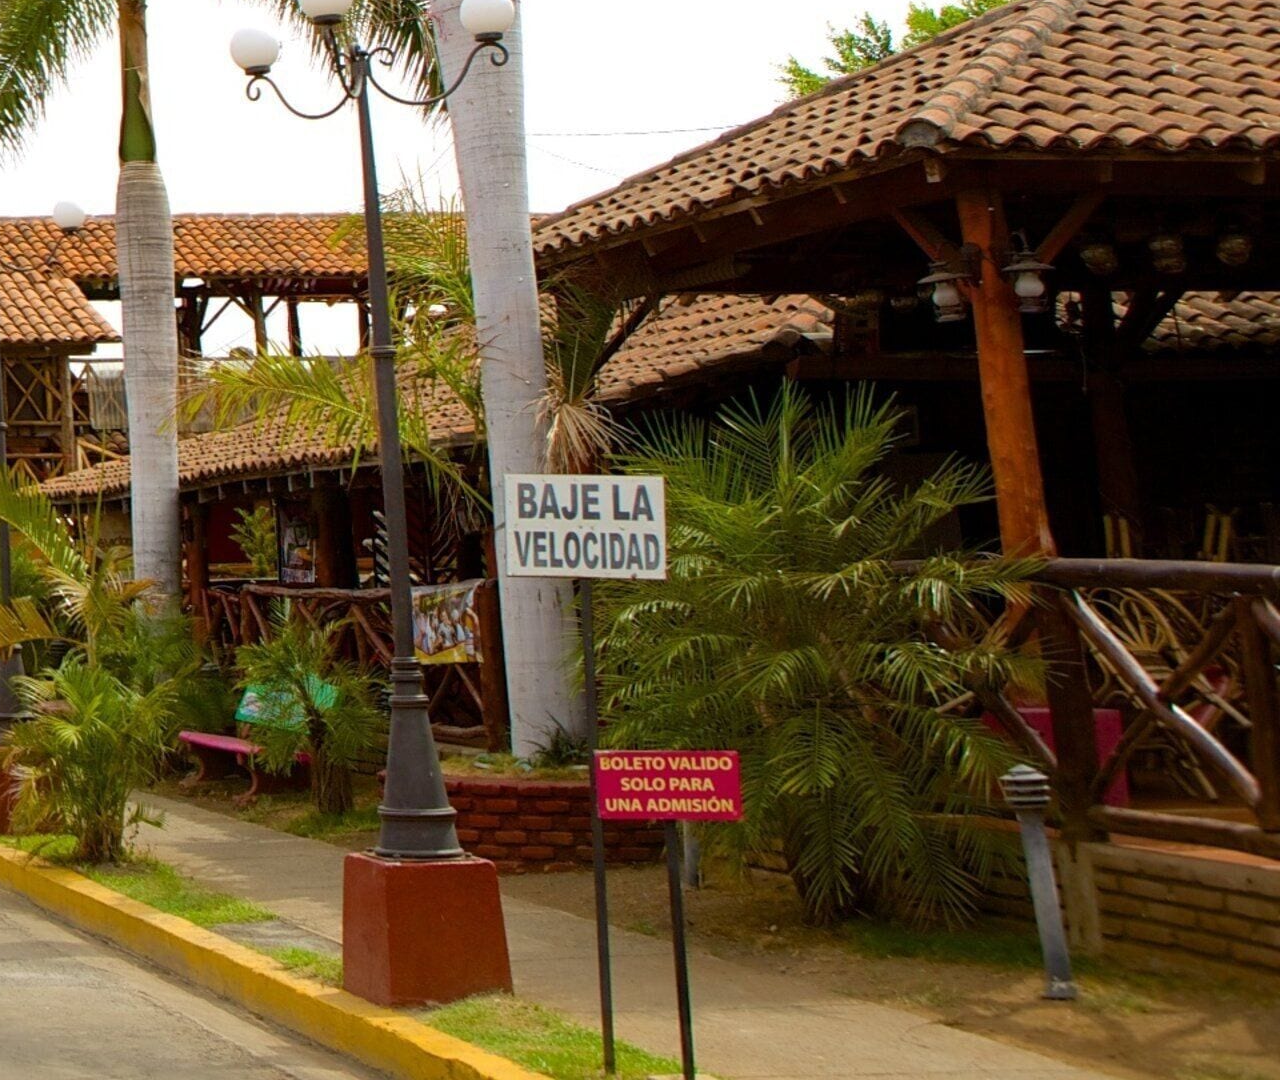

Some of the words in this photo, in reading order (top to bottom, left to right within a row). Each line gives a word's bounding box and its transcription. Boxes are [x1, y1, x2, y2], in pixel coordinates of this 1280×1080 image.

[517, 482, 600, 521] BAJE
[612, 484, 655, 522] LA
[514, 531, 661, 571] VELOCIDAD
[600, 756, 665, 771] BOLETO
[667, 757, 733, 771] VALIDO
[621, 778, 666, 792] SOLO
[669, 778, 715, 792] PARA
[605, 799, 642, 813] UNA
[646, 796, 735, 814] ADMISIÓN
